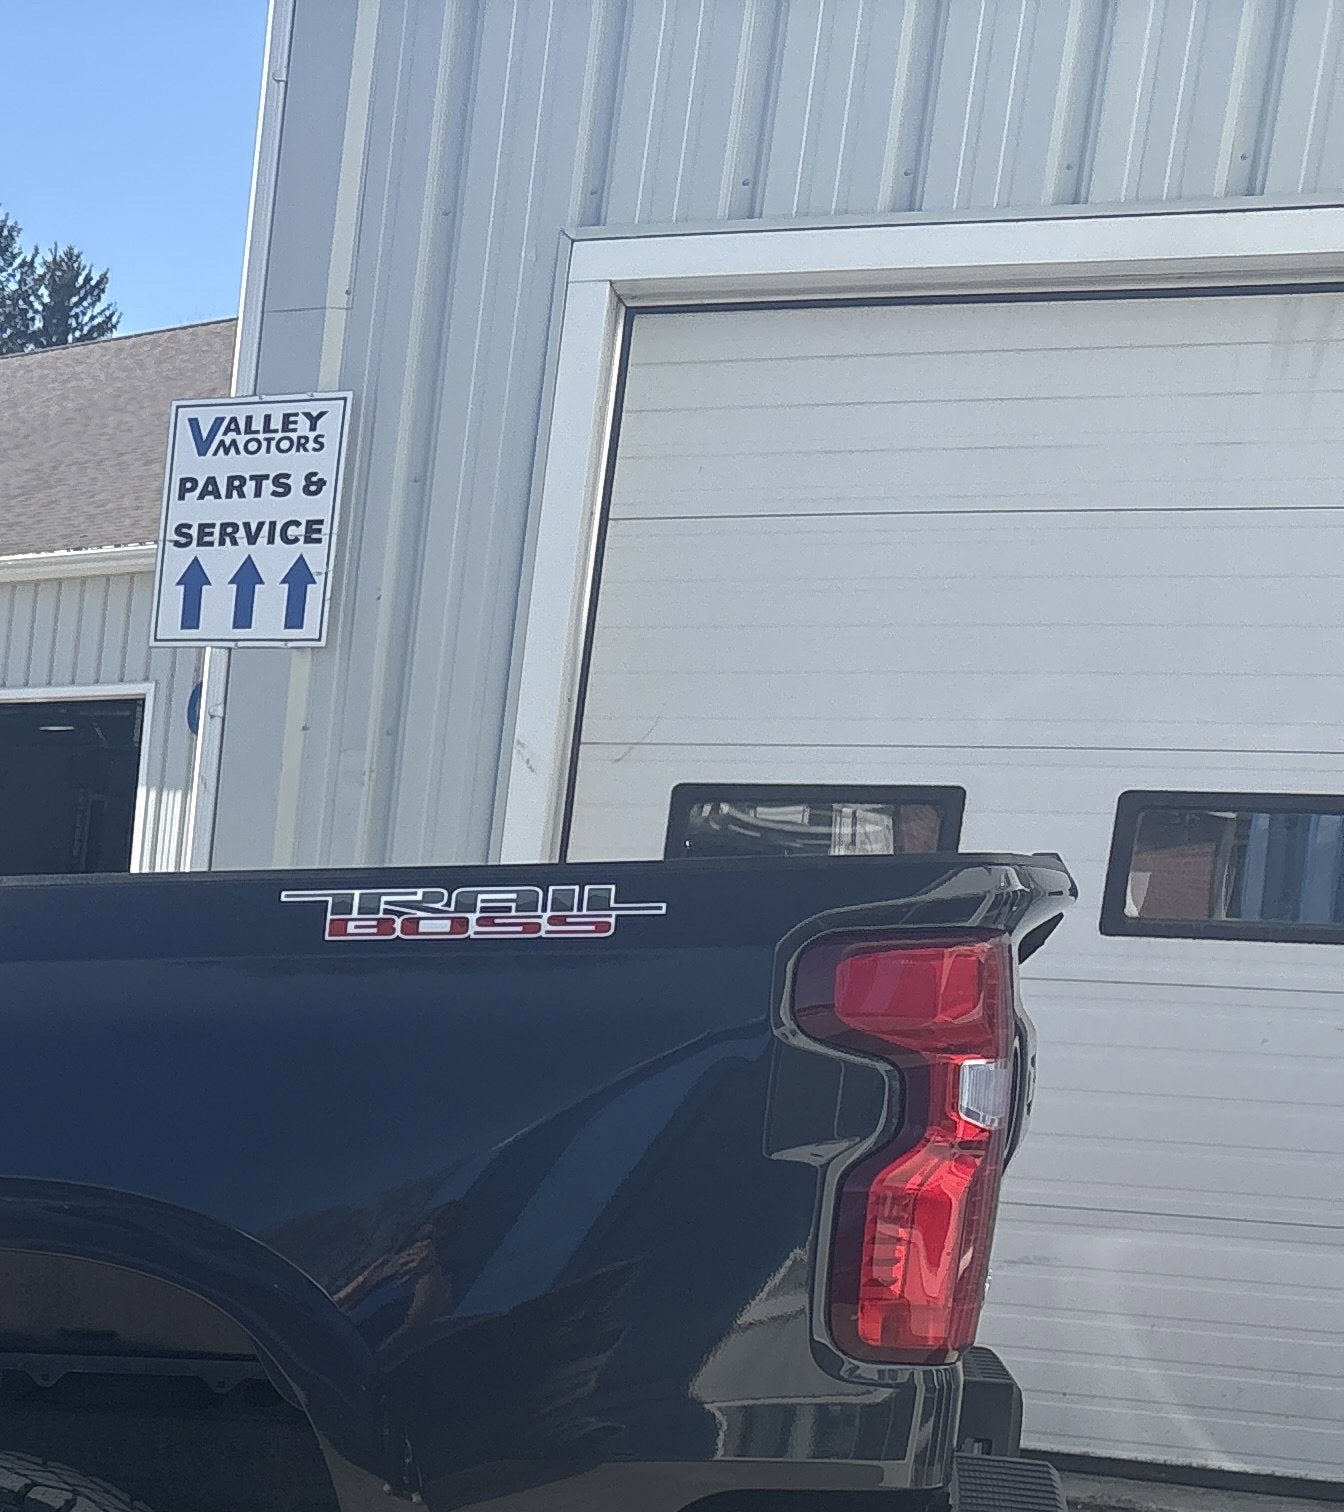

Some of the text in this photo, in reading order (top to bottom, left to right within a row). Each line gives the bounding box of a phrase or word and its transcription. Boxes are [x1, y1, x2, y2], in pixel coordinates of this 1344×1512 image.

[187, 409, 329, 457] VALLEY
[212, 434, 325, 456] MOTORS
[177, 471, 327, 501] PARTS &
[173, 518, 325, 548] SERVICE
[280, 884, 667, 917] TRAIL
[324, 912, 616, 941] BOSS
